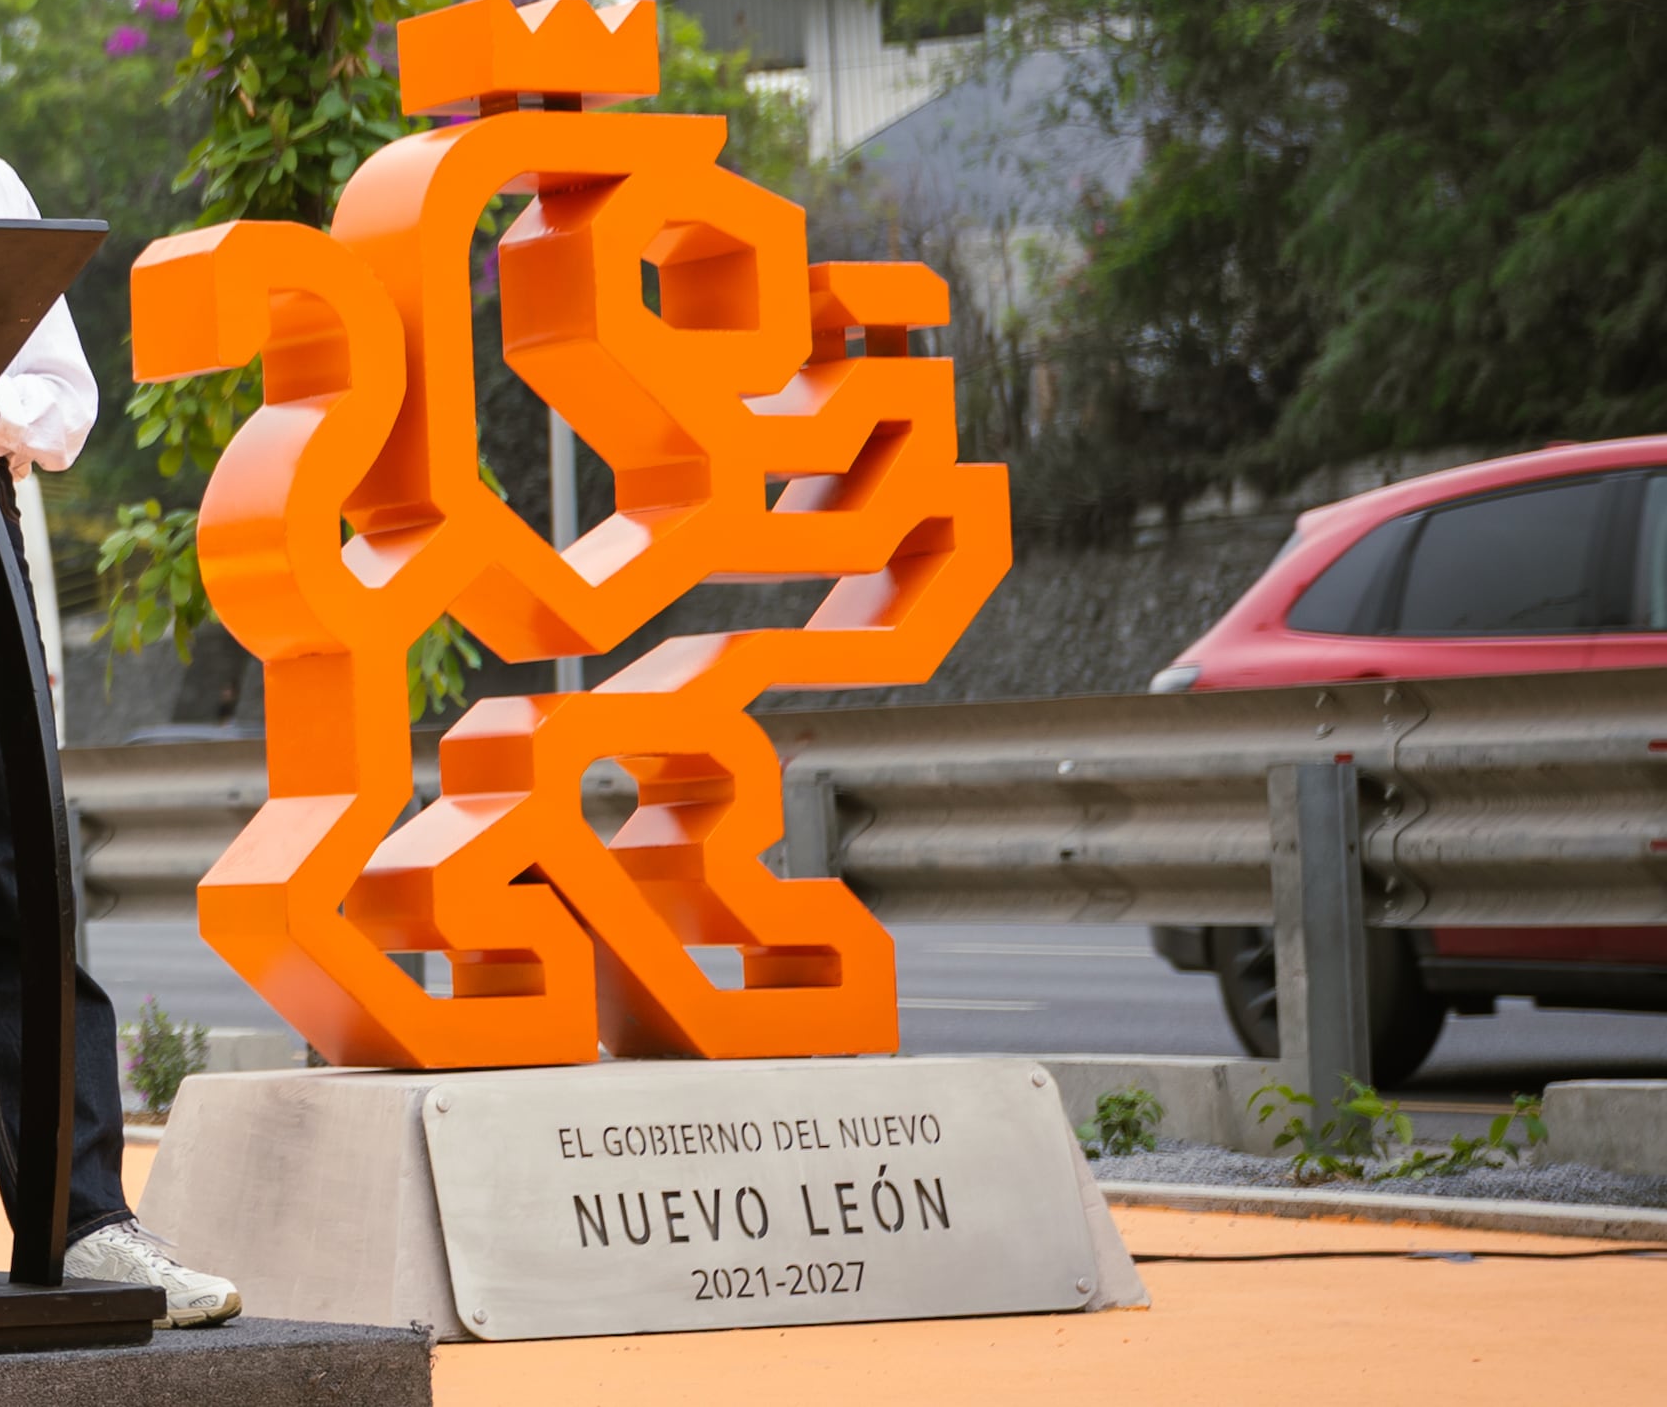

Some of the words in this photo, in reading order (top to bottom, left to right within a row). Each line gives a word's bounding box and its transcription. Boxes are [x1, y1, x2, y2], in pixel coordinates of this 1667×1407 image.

[559, 1128, 593, 1159] EL
[602, 1120, 762, 1156] GOBIERNO
[773, 1119, 830, 1152] DEL
[838, 1113, 942, 1147] NUEVO
[572, 1185, 769, 1247] NUEVO
[801, 1164, 951, 1237] LEÓN
[691, 1261, 866, 1301] 2021-2027
